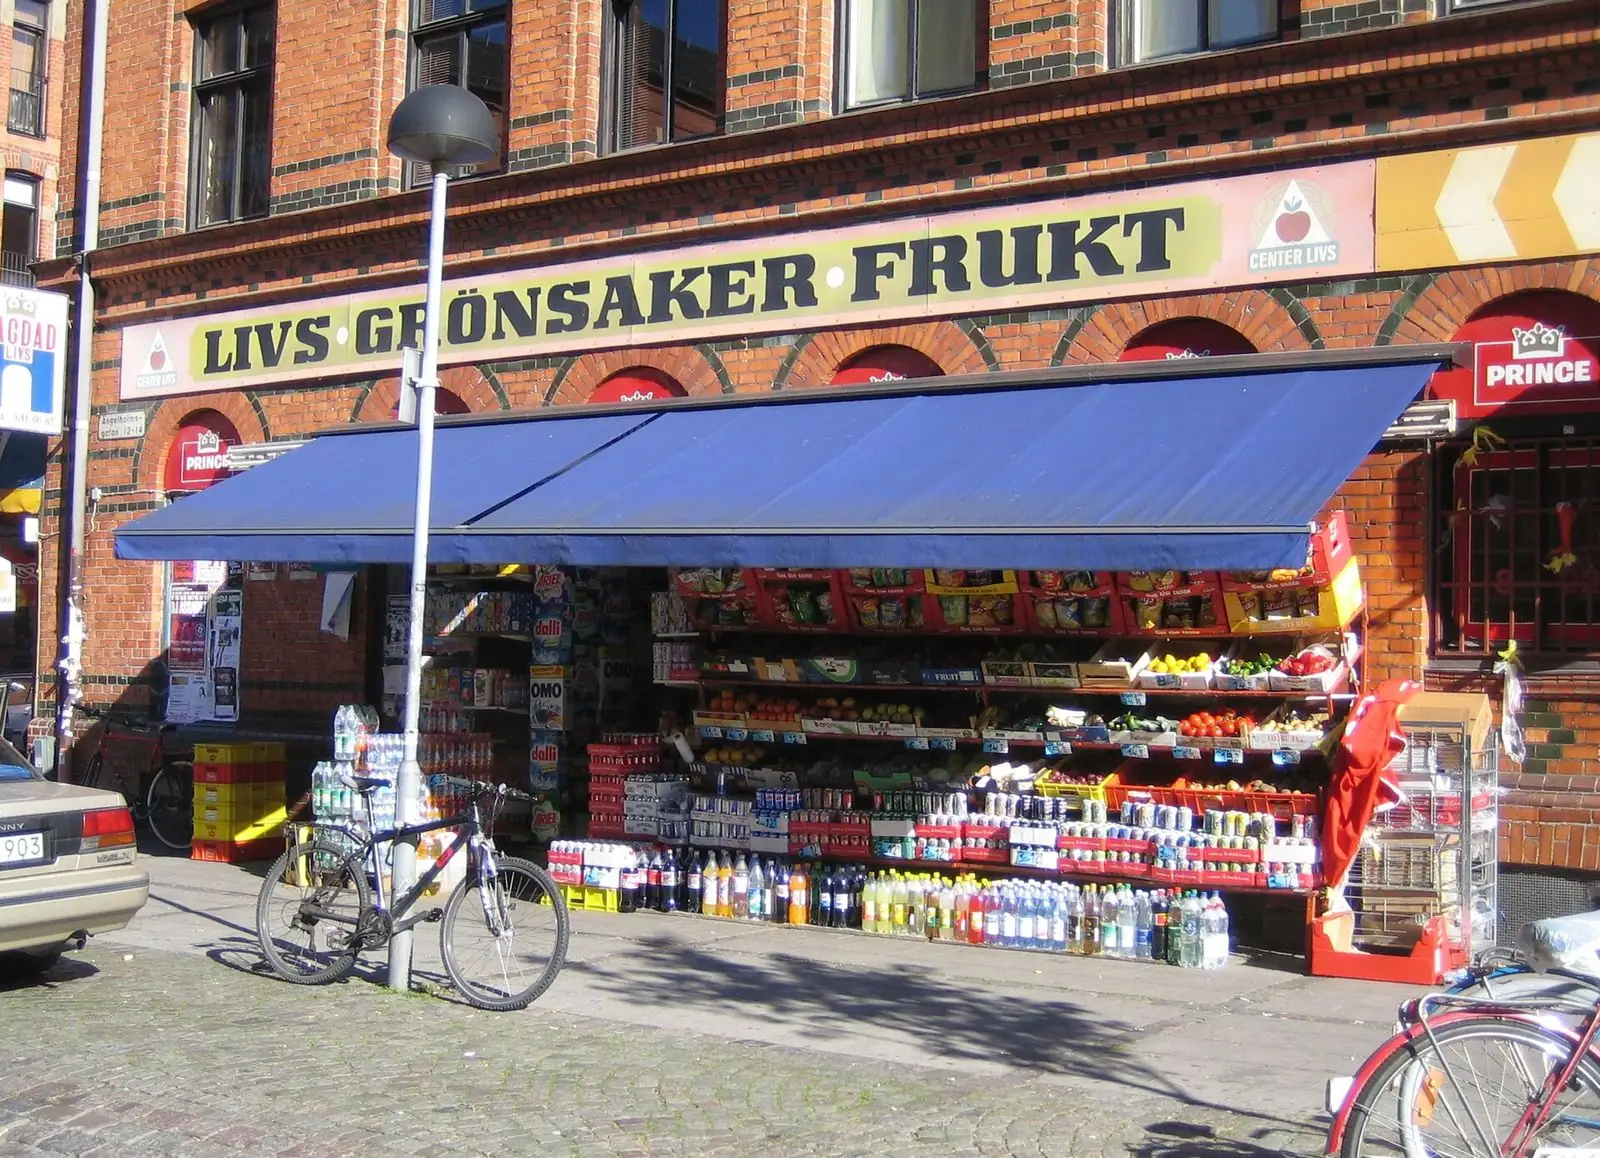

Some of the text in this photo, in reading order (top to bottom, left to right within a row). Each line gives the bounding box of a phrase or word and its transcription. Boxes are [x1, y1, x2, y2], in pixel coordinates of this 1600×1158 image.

[1249, 244, 1337, 269] CENTER LIVS
[203, 206, 1185, 375] LIVS GRÖNSAKER FRUKT
[6, 345, 31, 361] LIVS
[1487, 360, 1591, 387] PRINCE
[186, 454, 229, 471] PRINCE
[536, 619, 561, 636] dalli
[935, 672, 959, 681] FRUIT
[531, 683, 562, 699] OMO
[532, 744, 557, 761] dalli
[5, 836, 40, 859] 903
